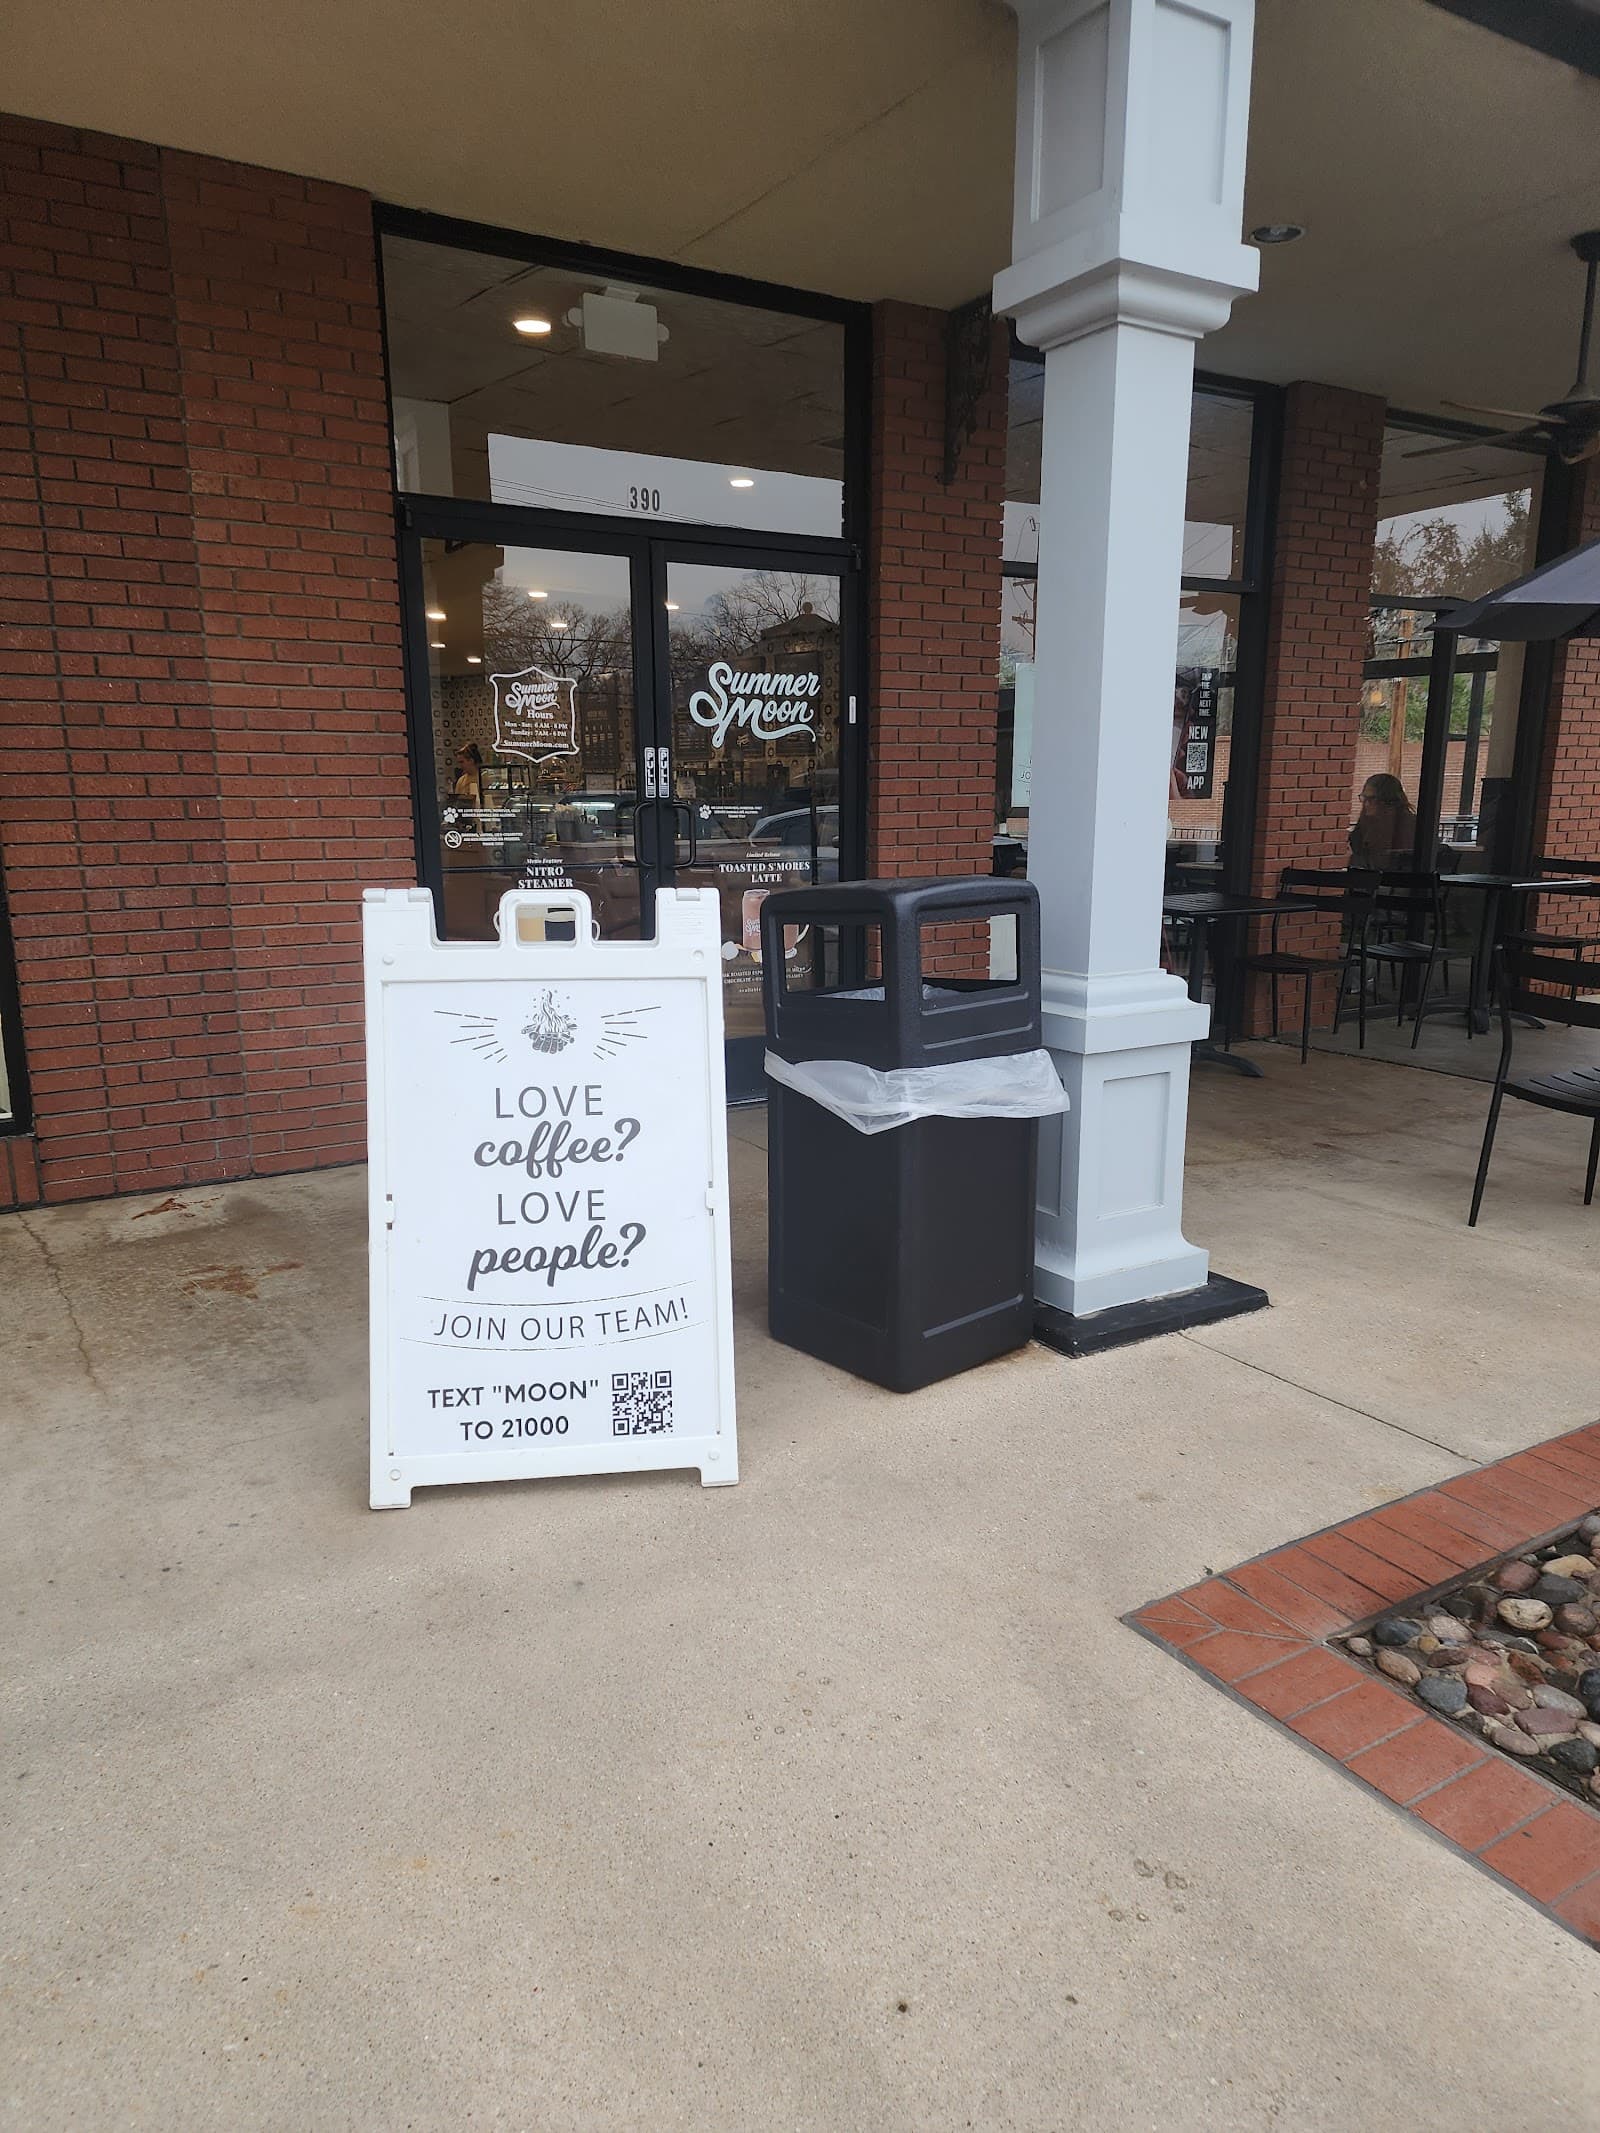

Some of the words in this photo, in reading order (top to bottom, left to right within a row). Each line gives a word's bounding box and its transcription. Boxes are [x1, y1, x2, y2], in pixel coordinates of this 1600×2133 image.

[630, 486, 660, 512] 390
[505, 681, 559, 708] Summer
[516, 693, 560, 715] Moon
[689, 661, 821, 727] Summer
[1199, 699, 1212, 708] NEXT
[527, 709, 554, 719] Hours
[712, 697, 816, 748] Moon
[503, 740, 569, 748] SummerMoon.com
[1188, 725, 1209, 740] NEW
[660, 752, 668, 786] PULL
[1187, 775, 1205, 790] APP
[526, 866, 564, 877] NITRO
[719, 863, 766, 873] TOASTED
[768, 861, 810, 872] S'MORES
[751, 873, 783, 883] LATTE
[518, 878, 574, 889] STEAMER
[495, 1084, 604, 1119] LOVE
[473, 1117, 642, 1179] coffee?
[497, 1189, 606, 1225] LOVE
[467, 1222, 647, 1292] people?
[433, 1313, 507, 1341] JOIN
[520, 1315, 585, 1341] OUR
[594, 1297, 689, 1335] TEAM!
[427, 1386, 485, 1409] TEXT
[492, 1379, 600, 1404] "MOON"
[460, 1420, 494, 1441] TO
[501, 1415, 569, 1439] 21000
